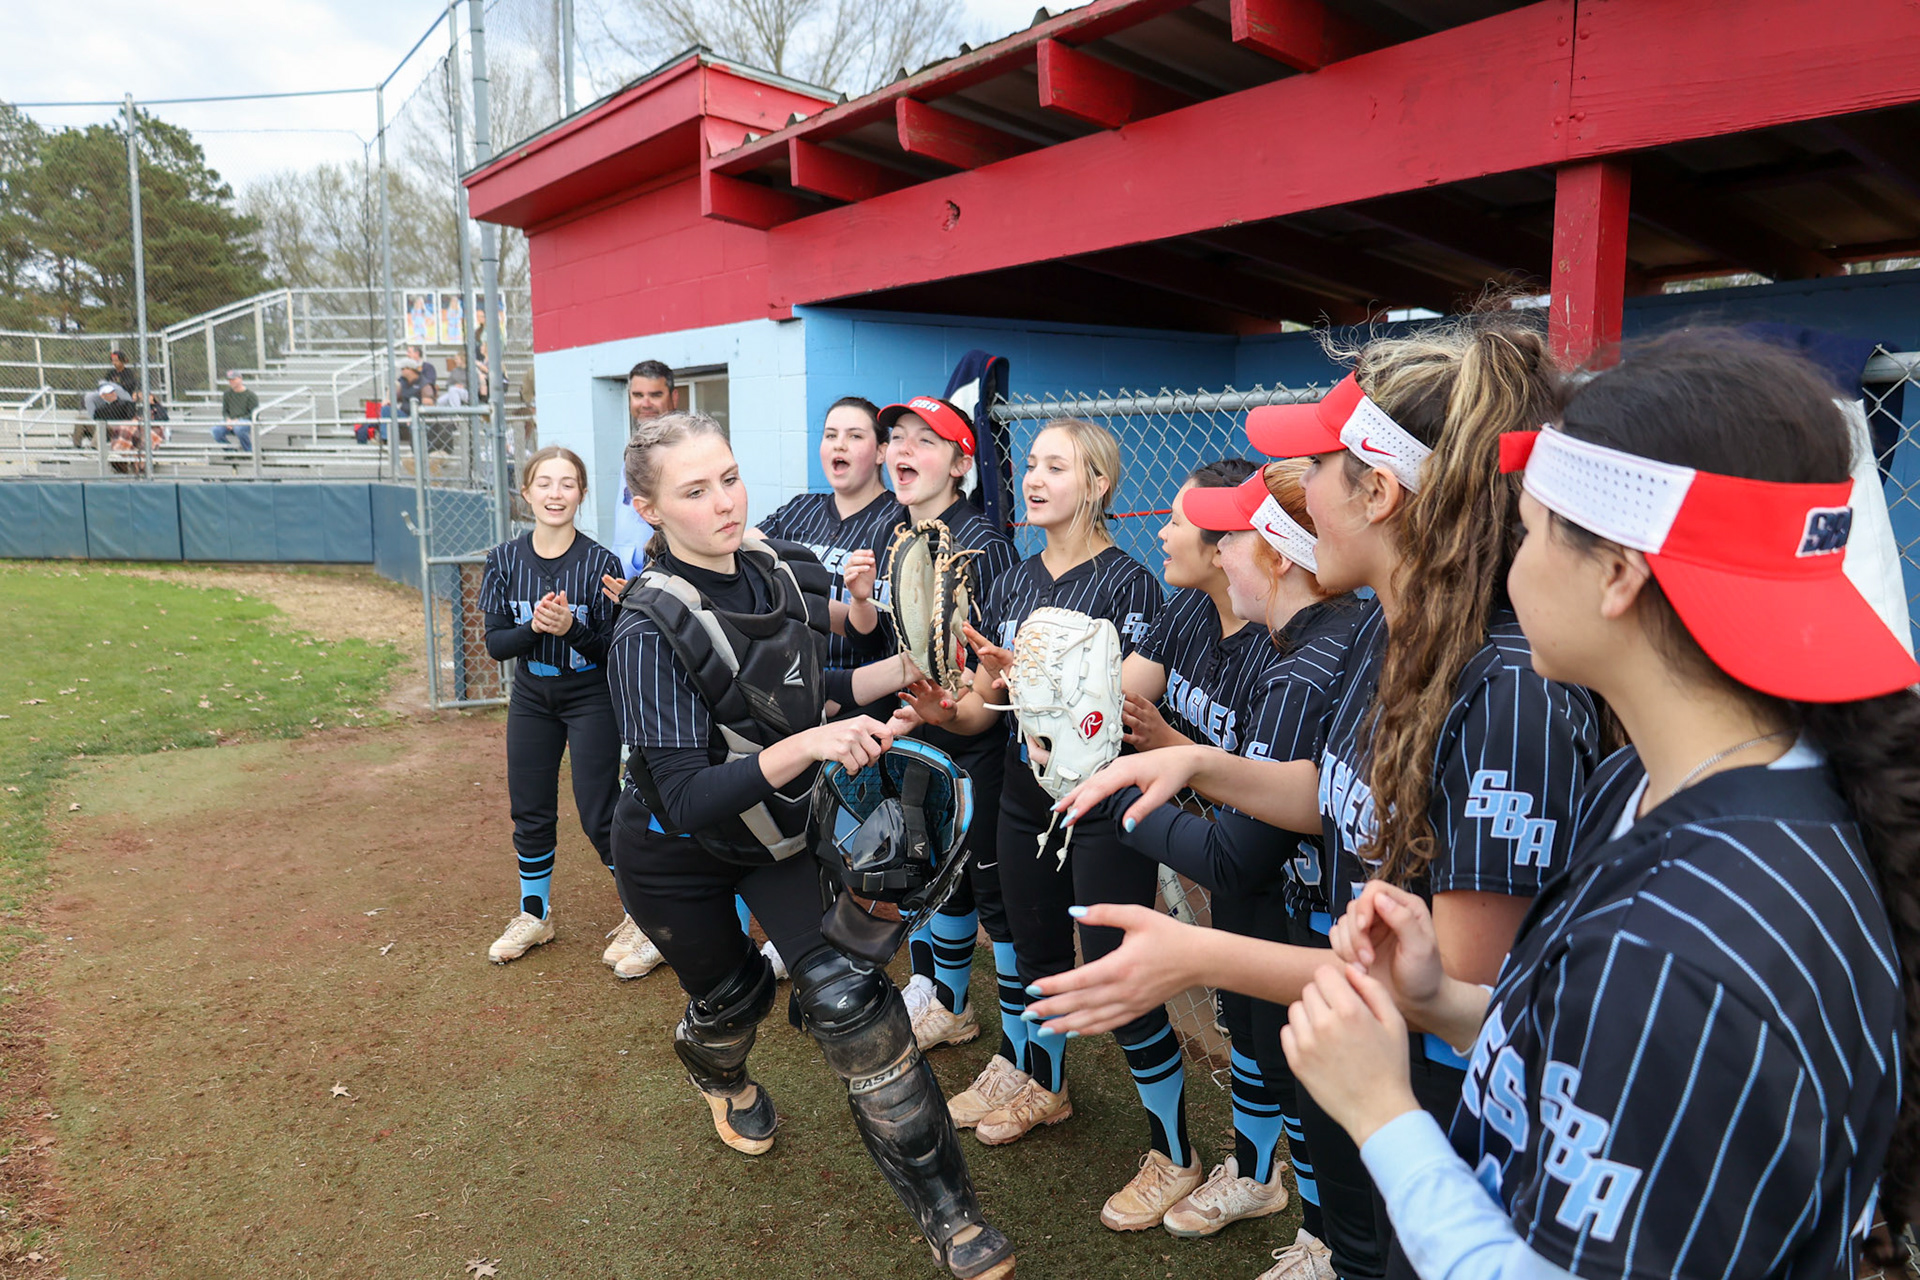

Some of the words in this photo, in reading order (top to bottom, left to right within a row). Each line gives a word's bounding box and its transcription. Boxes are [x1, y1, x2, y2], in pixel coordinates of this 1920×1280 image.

[1167, 668, 1239, 751] EAGLES
[1464, 769, 1557, 867] SBA
[1540, 1060, 1643, 1242] SBA
